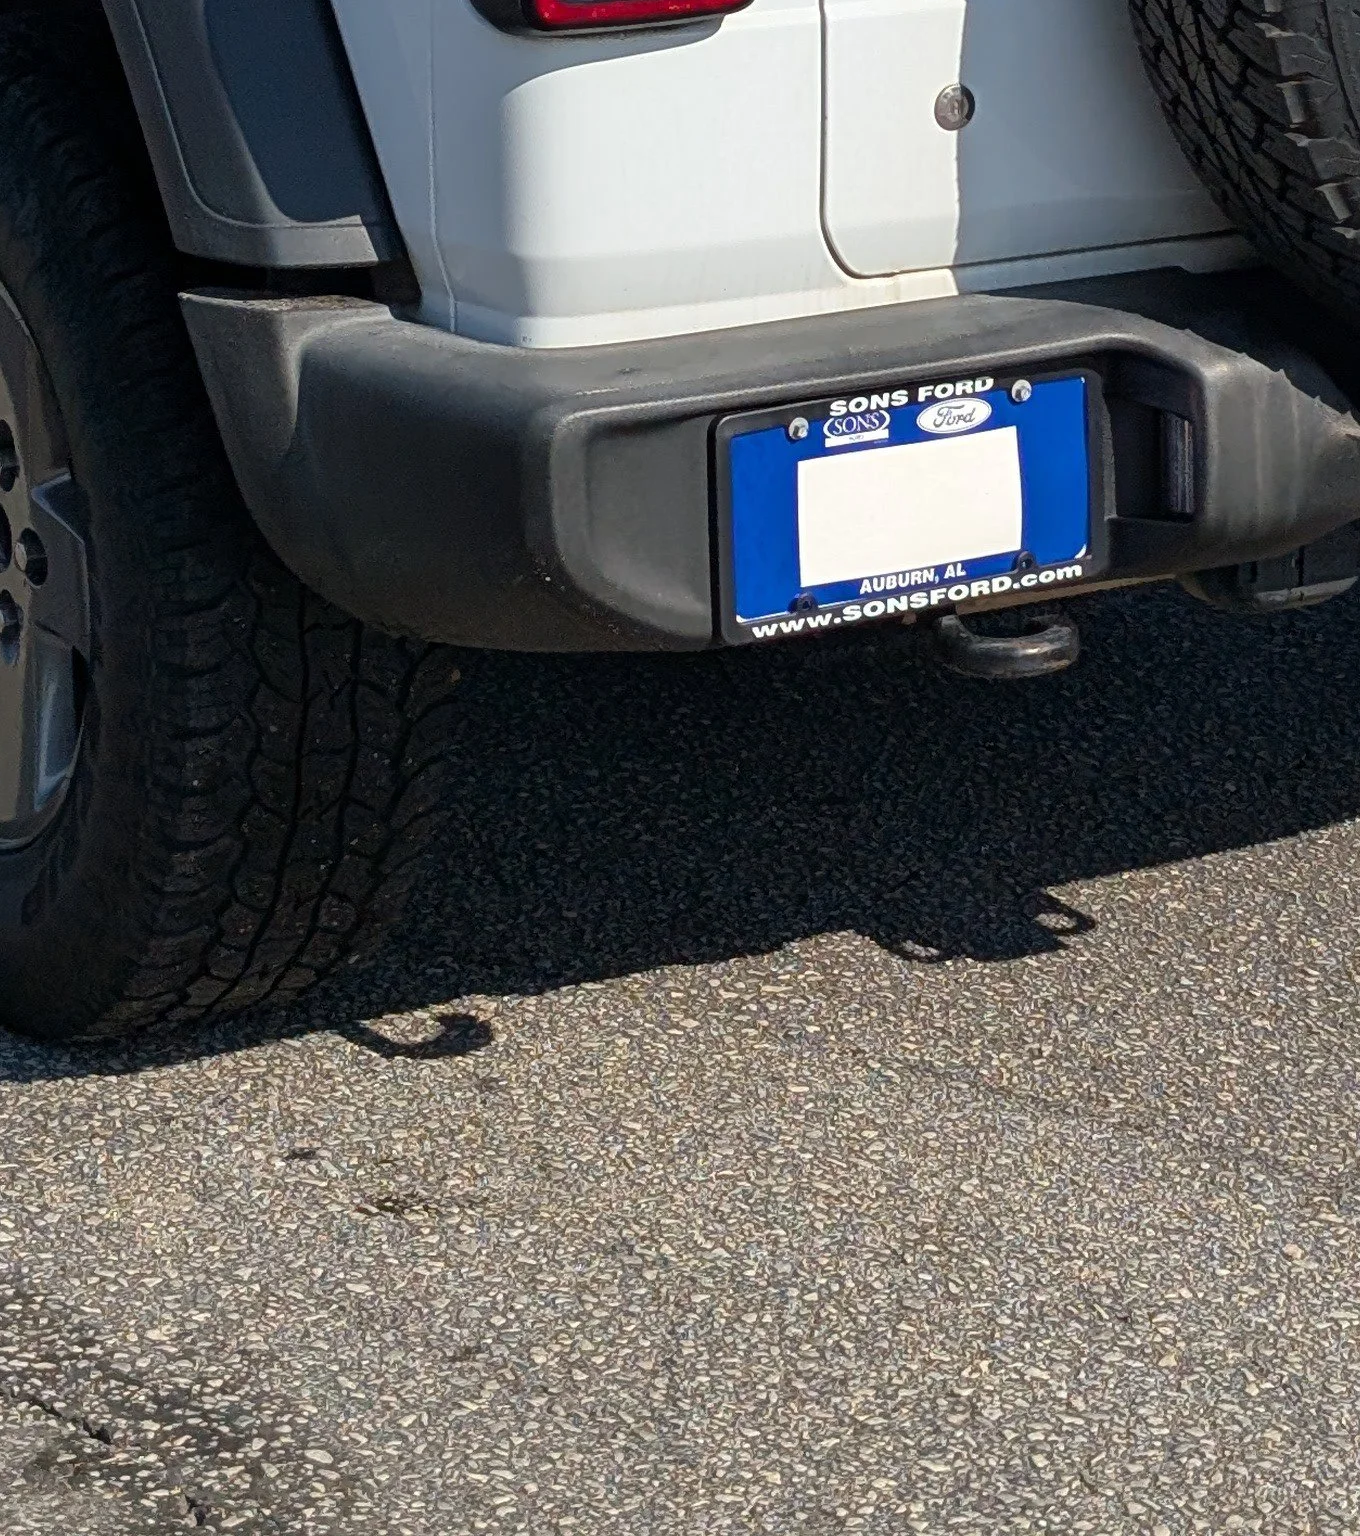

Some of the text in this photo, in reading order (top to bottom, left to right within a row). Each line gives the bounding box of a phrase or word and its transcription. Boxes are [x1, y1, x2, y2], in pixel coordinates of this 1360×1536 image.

[829, 376, 995, 417] SONS FORD
[932, 404, 976, 429] Ford
[859, 562, 967, 595] AUBURN, AL
[751, 564, 1083, 639] www.SONSFORD.com
